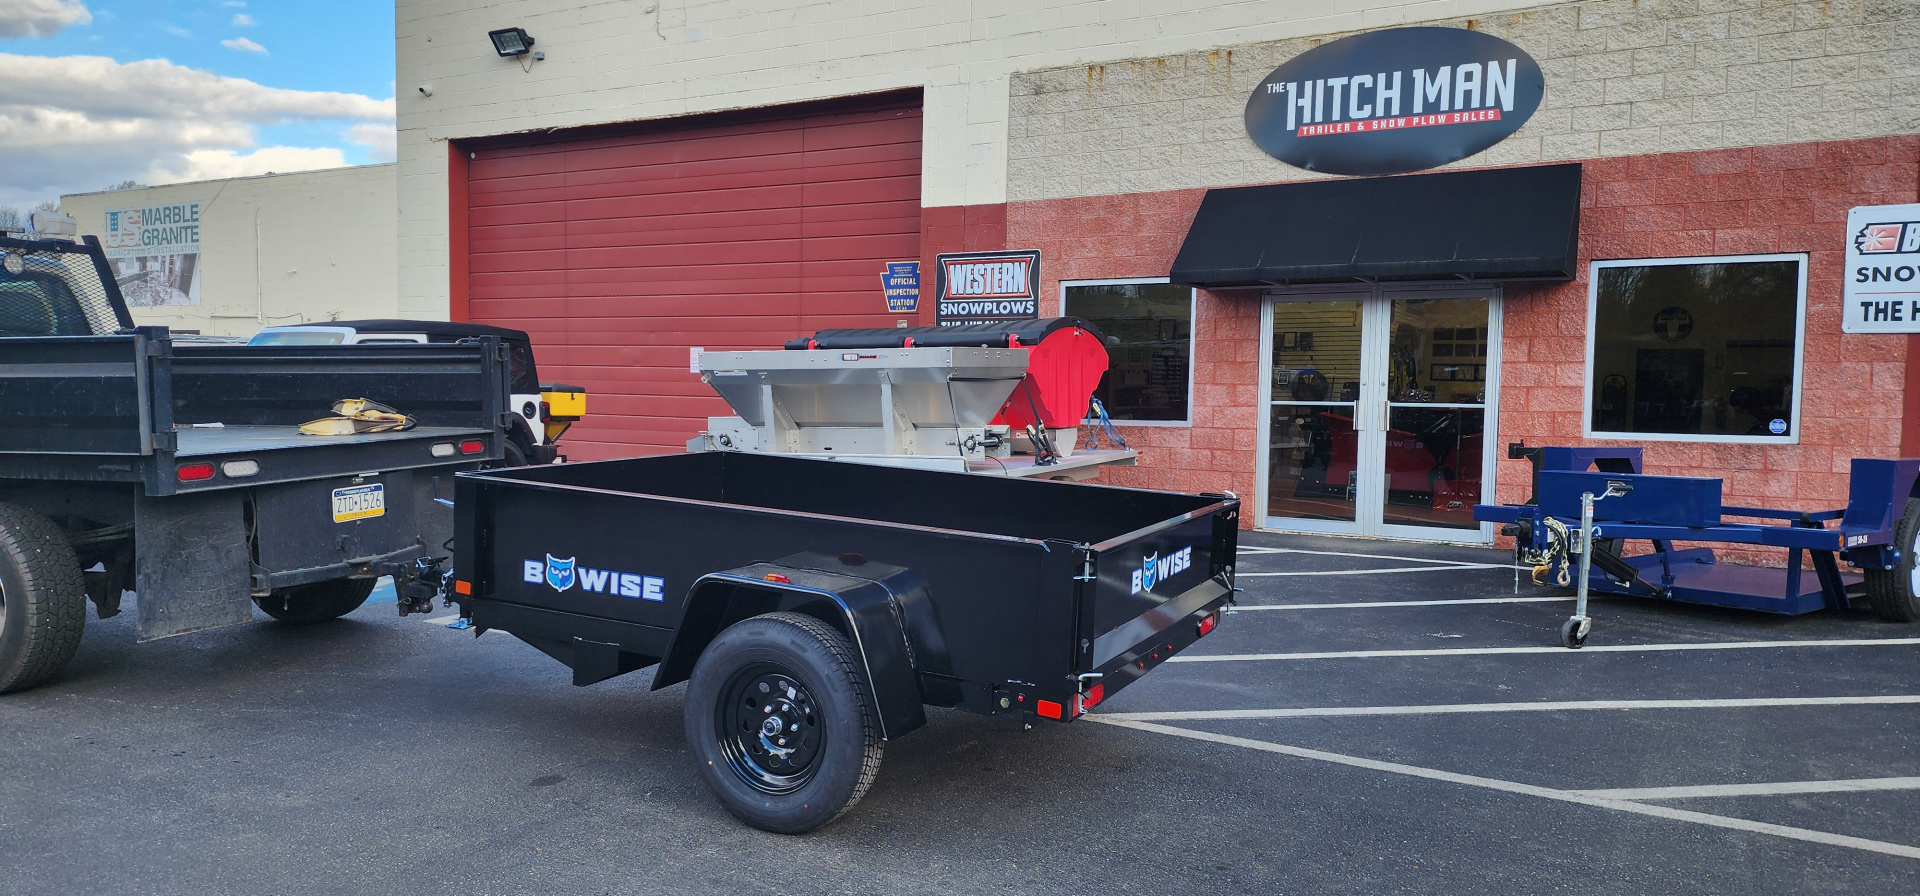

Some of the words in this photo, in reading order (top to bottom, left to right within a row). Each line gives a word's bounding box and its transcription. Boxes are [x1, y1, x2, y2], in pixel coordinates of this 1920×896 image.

[1266, 82, 1286, 94] THE
[1286, 71, 1402, 131] HITCH
[1412, 58, 1517, 114] MAN
[1302, 123, 1350, 135] TRAILER
[1357, 122, 1365, 131] &
[1372, 117, 1406, 129] SNOW
[1413, 114, 1447, 126] PLOW
[1454, 110, 1494, 122] SALES
[106, 209, 141, 248] US
[142, 204, 199, 226] MARBLE
[142, 225, 199, 246] GRANITE
[106, 248, 146, 257] FABRICATION
[153, 245, 200, 254] INSTALLATION
[890, 277, 917, 286] OFFICIAL
[949, 262, 1026, 295] WESTERN
[1855, 265, 1920, 283] SNO
[886, 288, 919, 296] INSPECTION
[890, 299, 915, 307] STATION
[940, 301, 1035, 315] SNOWPLOWS
[1860, 301, 1904, 321] THE
